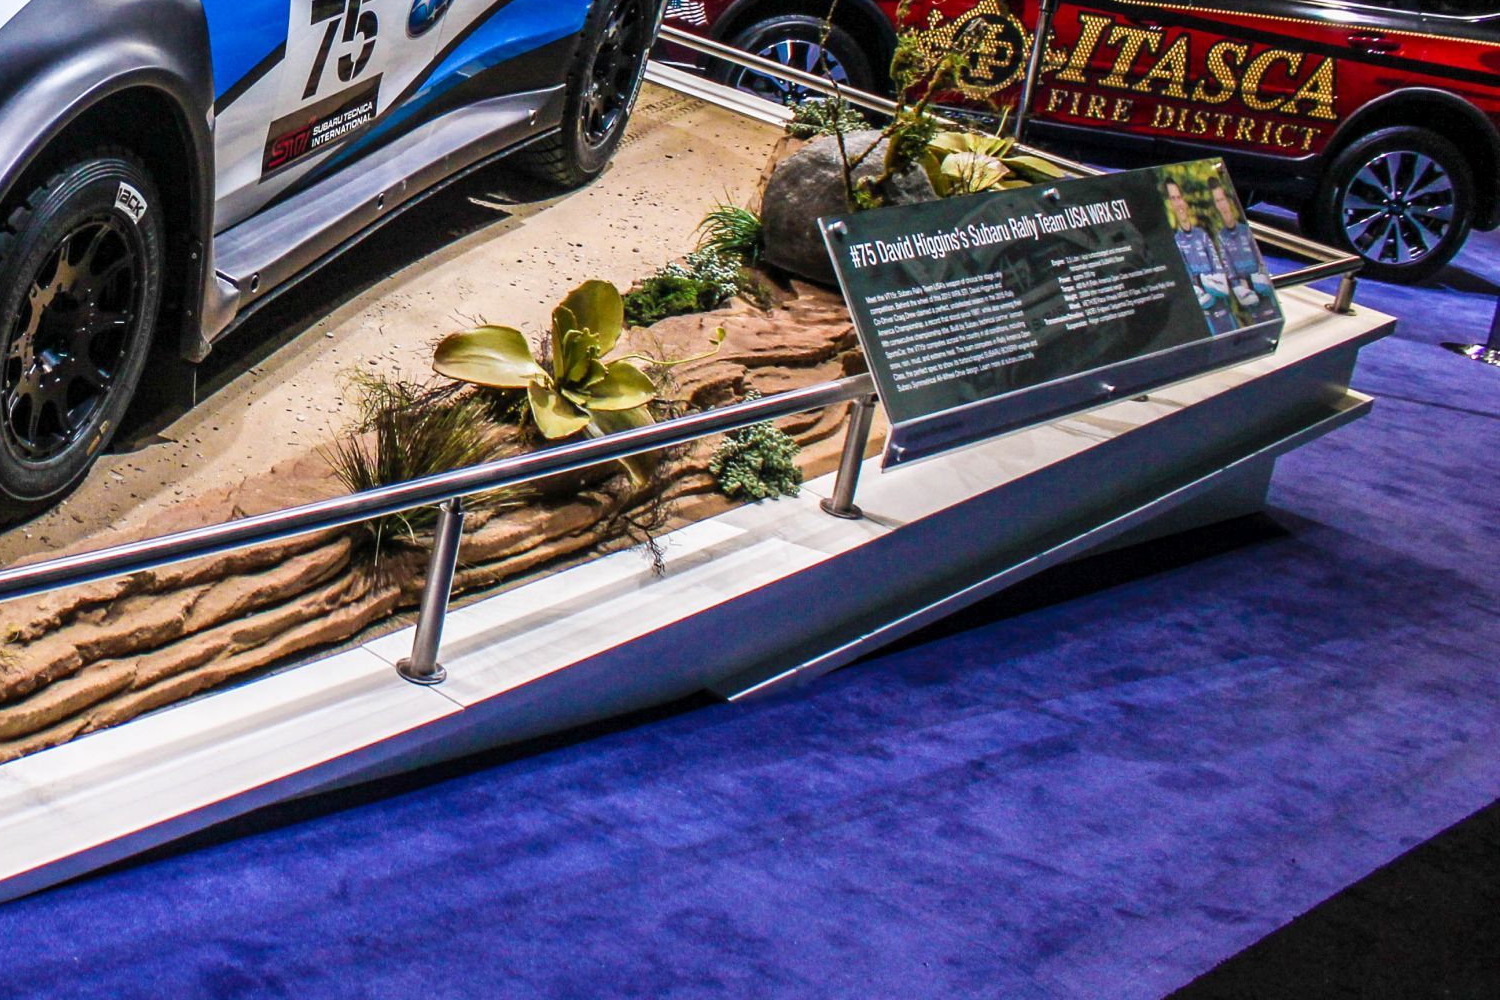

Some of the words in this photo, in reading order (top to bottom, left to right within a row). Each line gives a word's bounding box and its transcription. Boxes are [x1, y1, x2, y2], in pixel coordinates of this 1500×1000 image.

[1056, 11, 1338, 120] ITASCA
[311, 114, 373, 148] INTERNATIONAL
[313, 114, 344, 136] SUBARU
[343, 101, 373, 124] TECNICA
[1045, 88, 1134, 123] FIRE
[1151, 104, 1322, 152] DISTRICT
[850, 243, 877, 269] #75
[877, 236, 914, 263] David
[913, 228, 970, 260] Higgins's
[968, 222, 1010, 247] Subaru
[1007, 216, 1040, 241] Rally
[1035, 210, 1067, 235] Team
[1064, 207, 1090, 230] USA
[1087, 201, 1114, 224] WRX
[1113, 199, 1131, 220] STI
